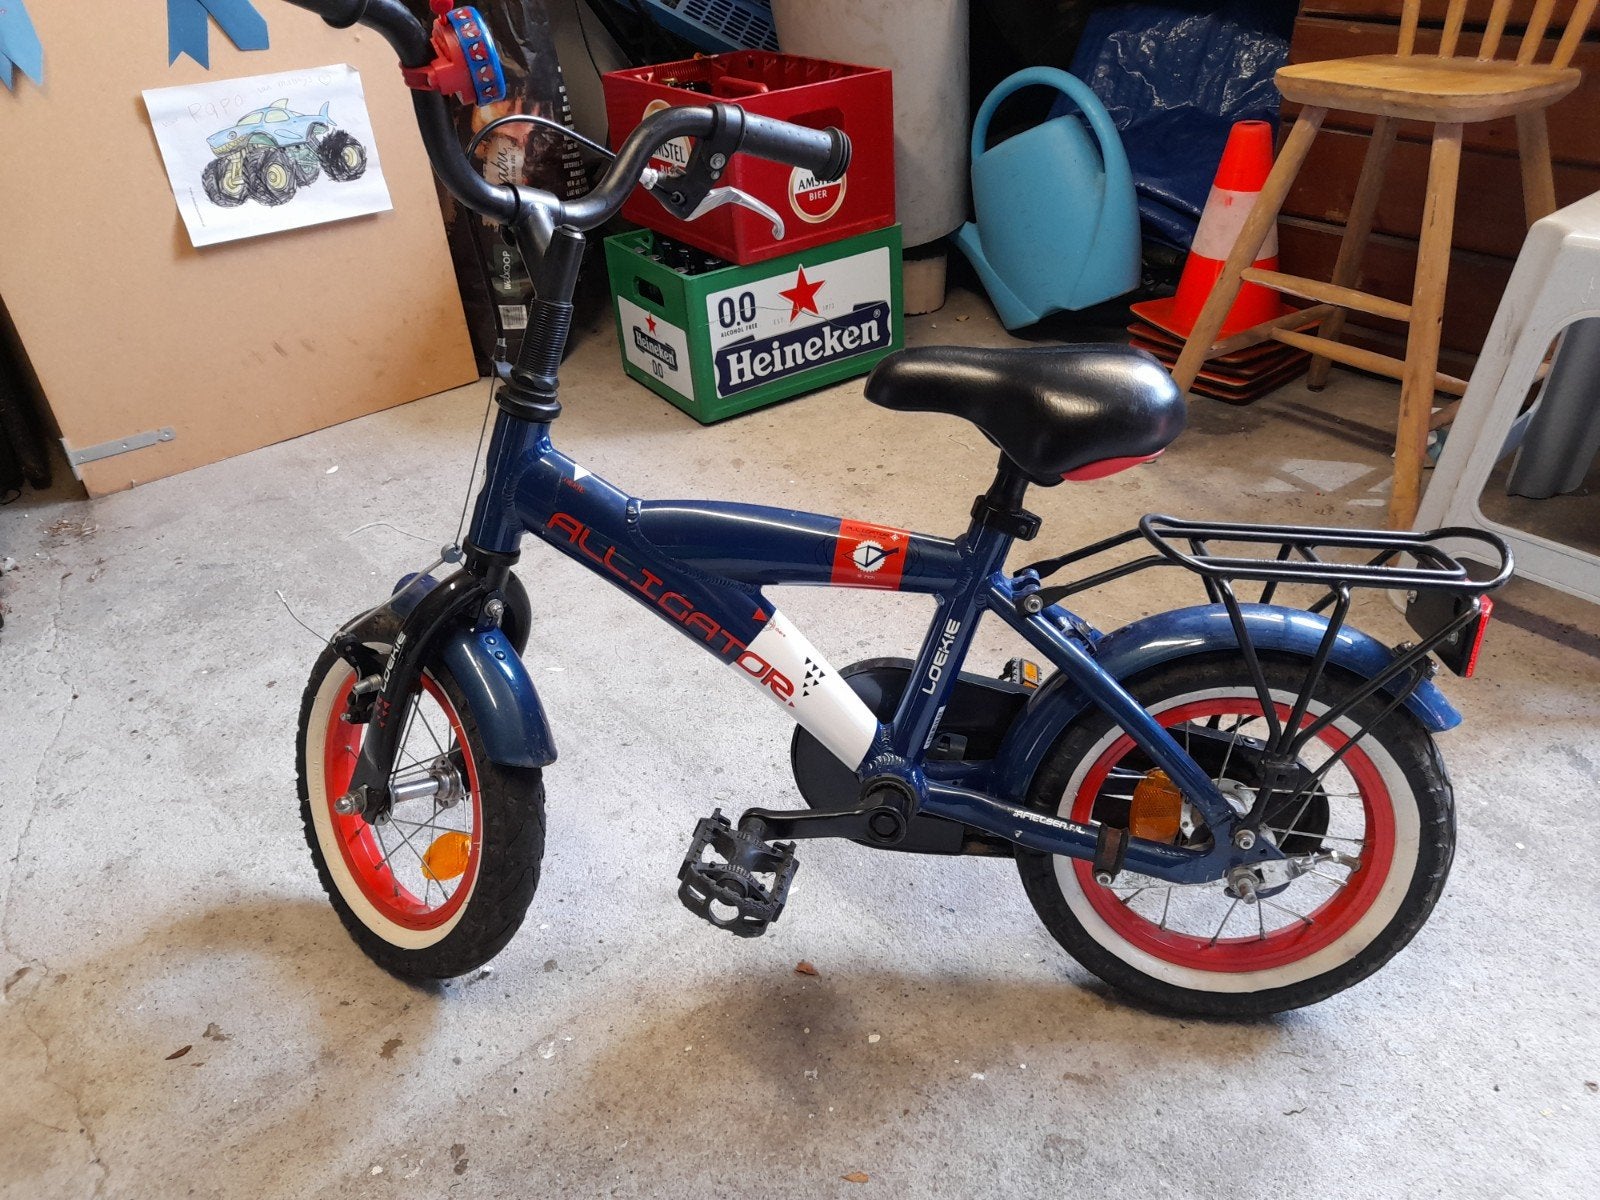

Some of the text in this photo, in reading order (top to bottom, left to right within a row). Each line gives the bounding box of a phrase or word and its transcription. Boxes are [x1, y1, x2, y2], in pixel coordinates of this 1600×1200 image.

[653, 142, 685, 164] MSTEL
[808, 189, 828, 201] BIER
[718, 291, 756, 328] 0.0
[635, 330, 676, 366] Heineken
[721, 322, 758, 338] ALCOHOL FREE
[727, 318, 881, 387] Heineken
[547, 512, 795, 702] ALLIGATOR
[922, 618, 961, 695] LOEKIE
